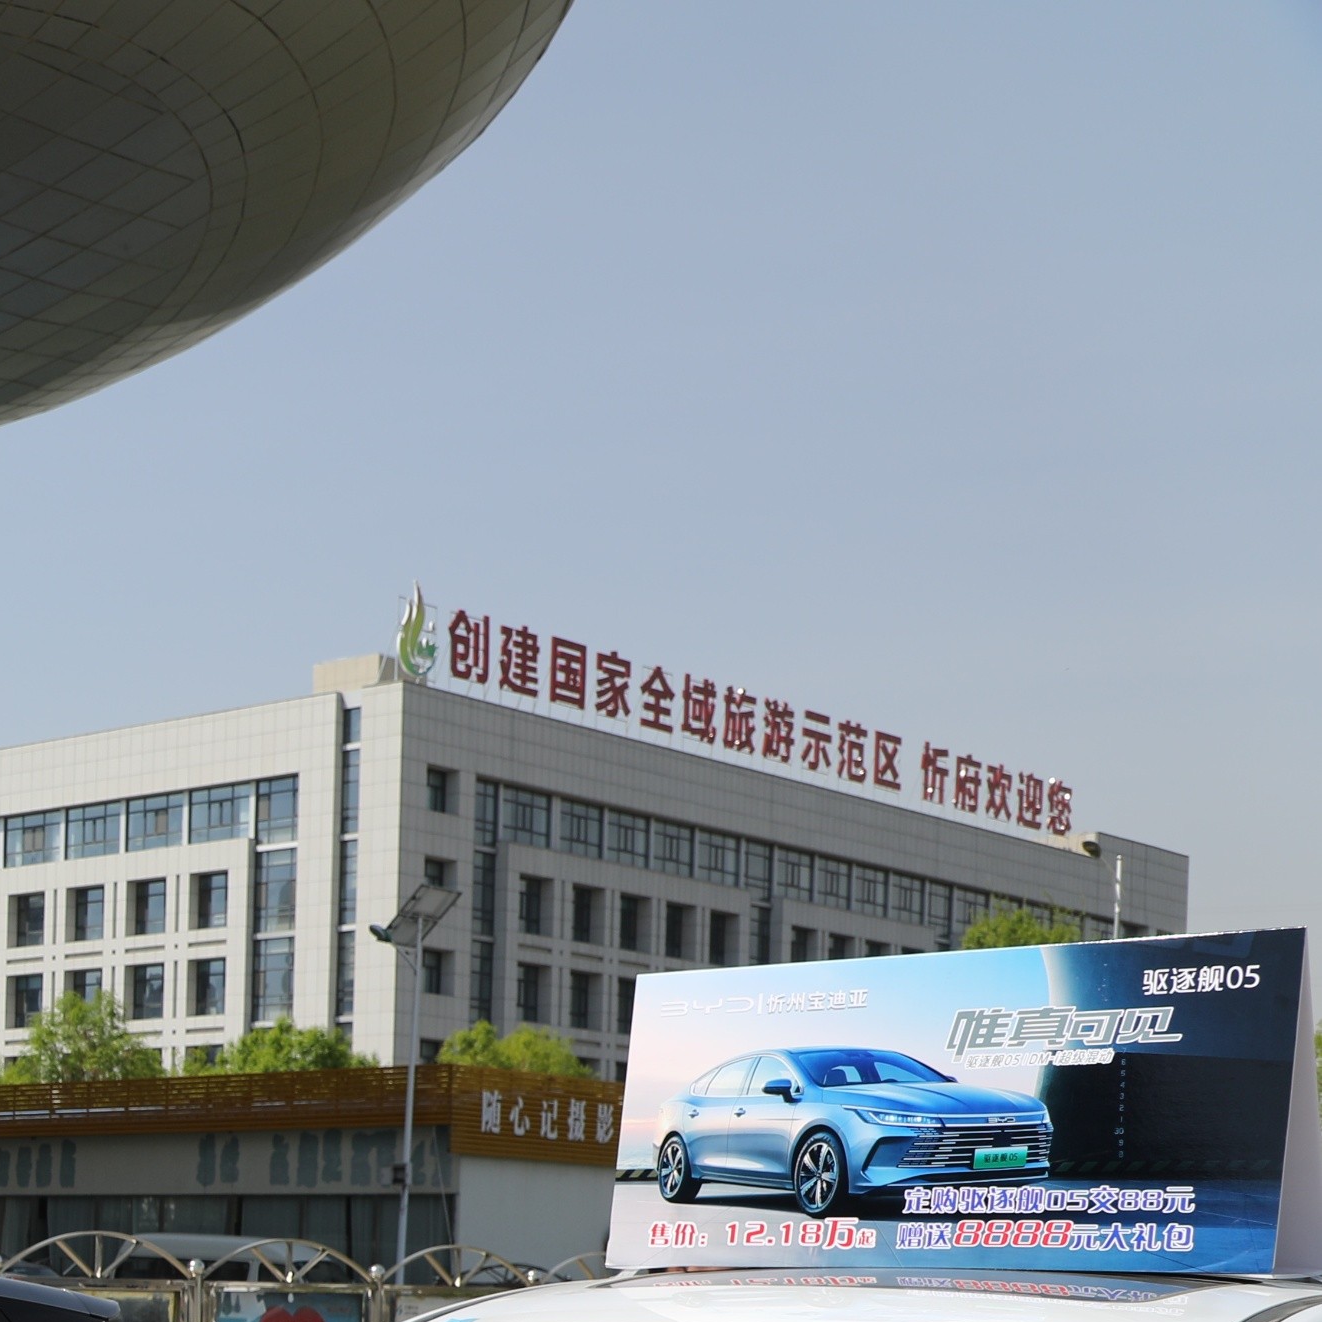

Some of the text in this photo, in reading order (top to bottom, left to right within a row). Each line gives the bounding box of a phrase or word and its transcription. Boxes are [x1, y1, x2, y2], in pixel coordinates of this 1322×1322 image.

[448, 608, 1074, 836] 创建国家全域旅游示范区 忻府欢迎您
[1142, 964, 1261, 997] 驱逐舰05
[766, 989, 869, 1014] 忻州宝迪亚
[945, 1005, 1184, 1064] 唯真可见
[480, 1088, 615, 1145] 随心记摄影
[901, 1185, 1196, 1215] 定购驱逐舰05交88元
[896, 1218, 1195, 1251] 赠送8888元大礼包
